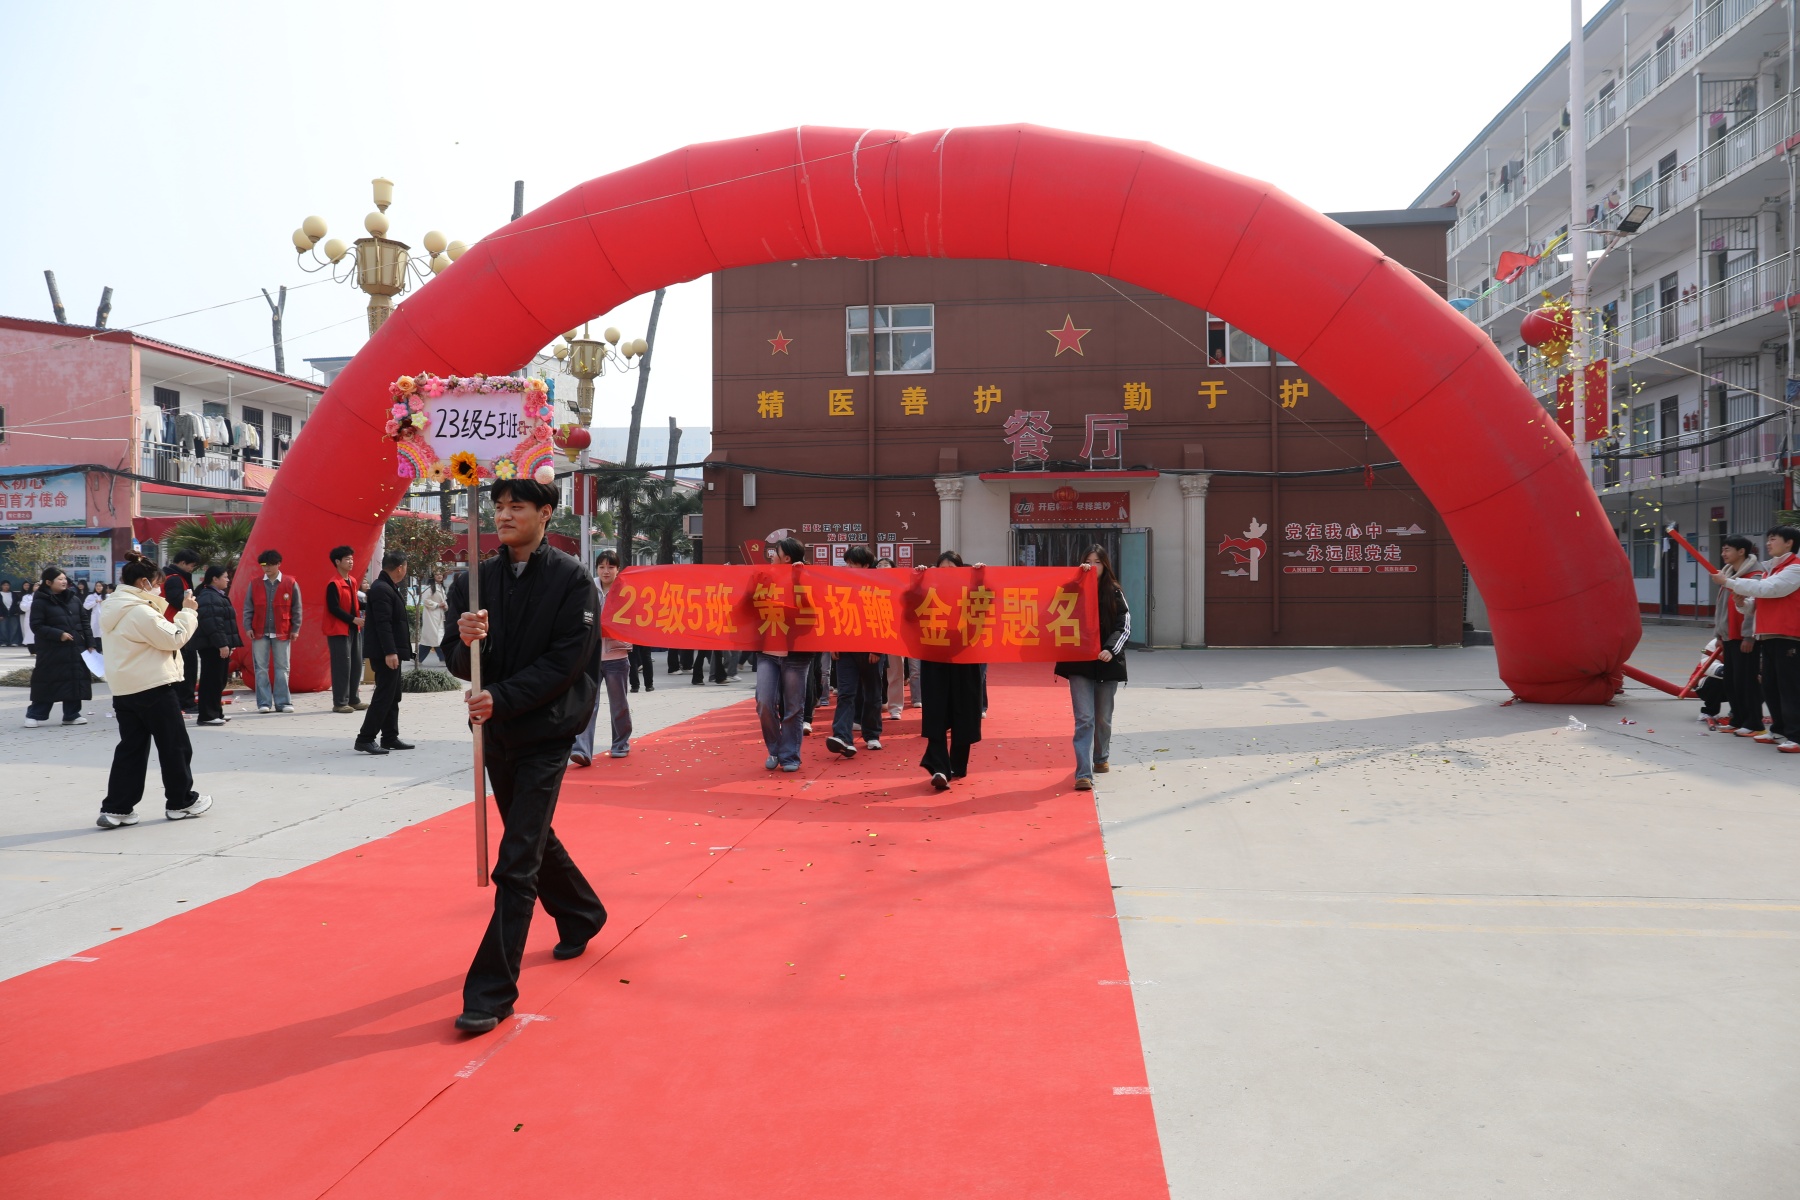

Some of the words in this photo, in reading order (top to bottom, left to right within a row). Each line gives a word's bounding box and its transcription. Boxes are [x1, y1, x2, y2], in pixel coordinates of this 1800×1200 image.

[757, 385, 1002, 419] 精医善护
[434, 408, 518, 440] 23级5班
[1003, 409, 1129, 461] 餐厅
[1285, 522, 1382, 540] 党在我心中
[1306, 544, 1402, 561] 永远跟党走
[612, 580, 738, 635] 23级5班
[752, 581, 898, 641] 策马扬鞭
[914, 585, 1082, 647] 金榜题名
